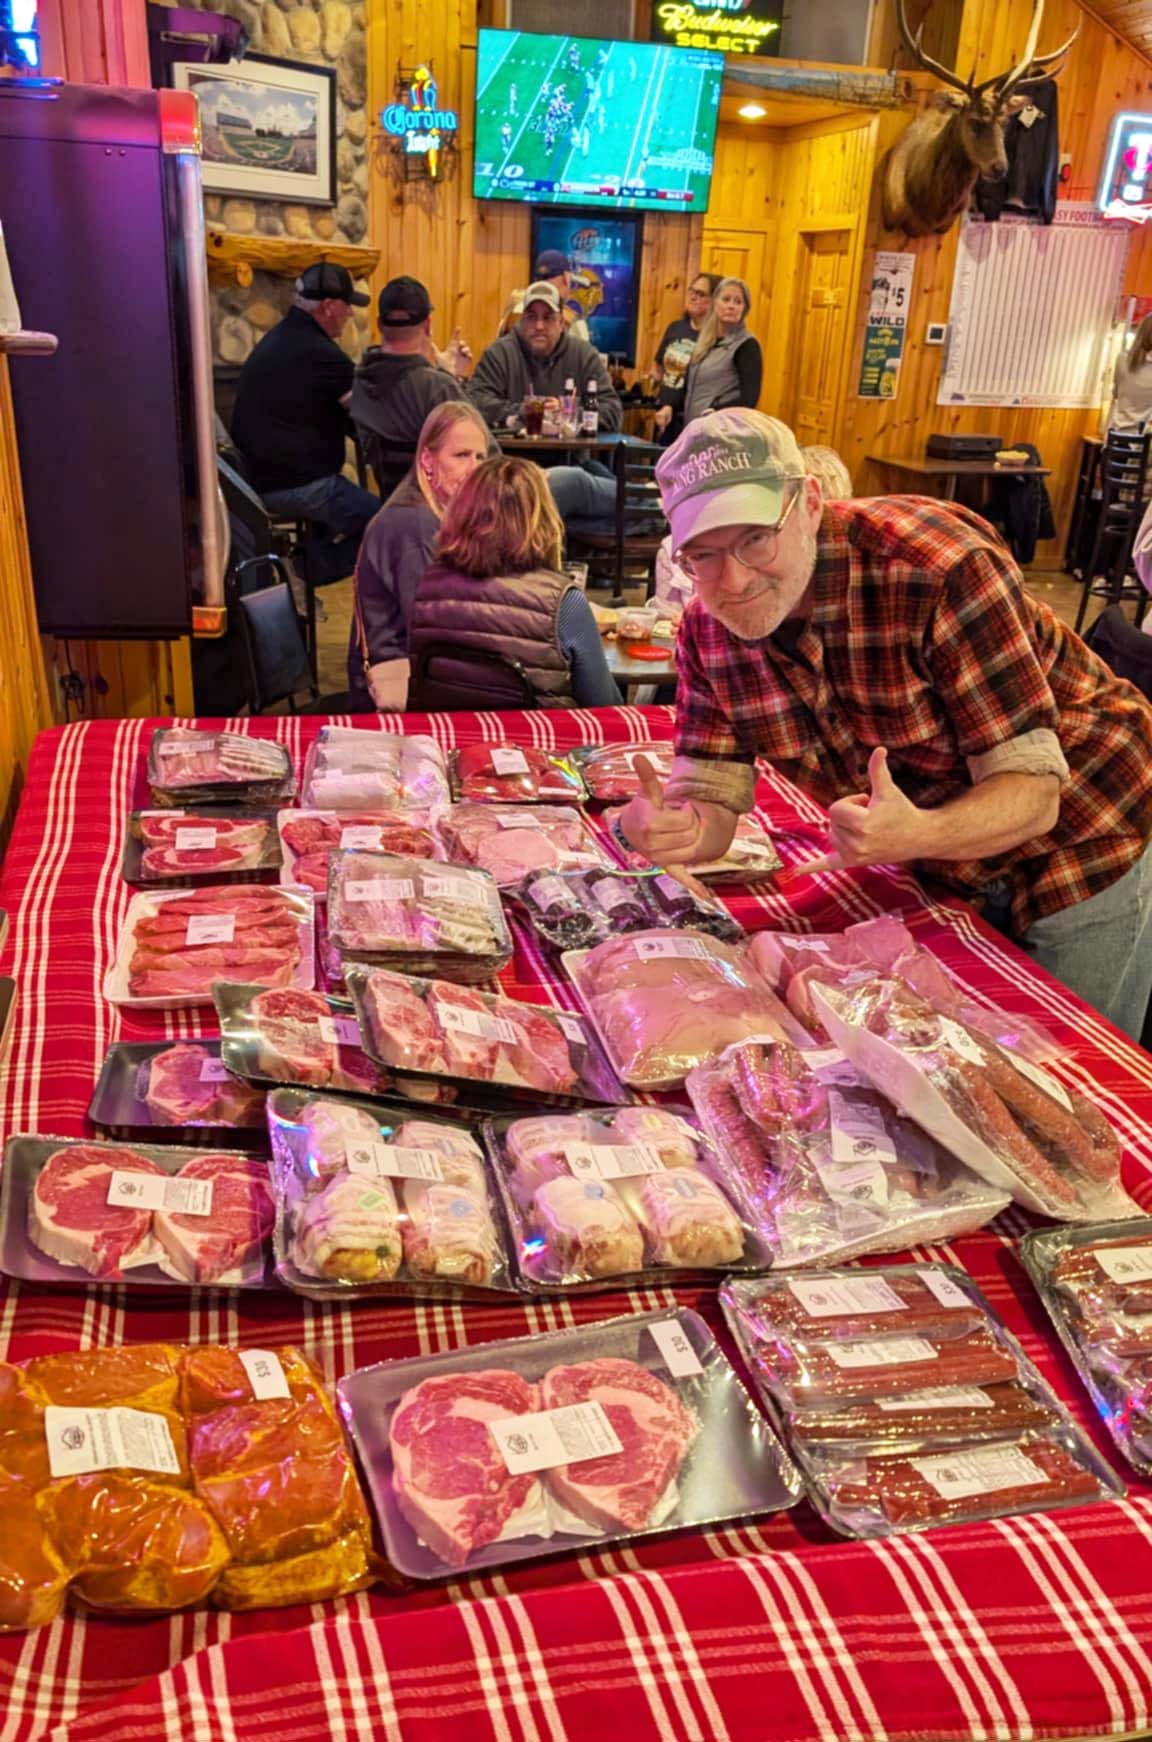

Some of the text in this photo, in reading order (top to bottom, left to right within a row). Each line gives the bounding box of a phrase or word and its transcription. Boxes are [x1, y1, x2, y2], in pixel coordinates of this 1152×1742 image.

[658, 3, 778, 36] Budweiser
[676, 32, 761, 53] SELECT
[382, 104, 458, 136] Corona
[870, 315, 905, 326] WILD
[697, 451, 752, 479] RANCH
